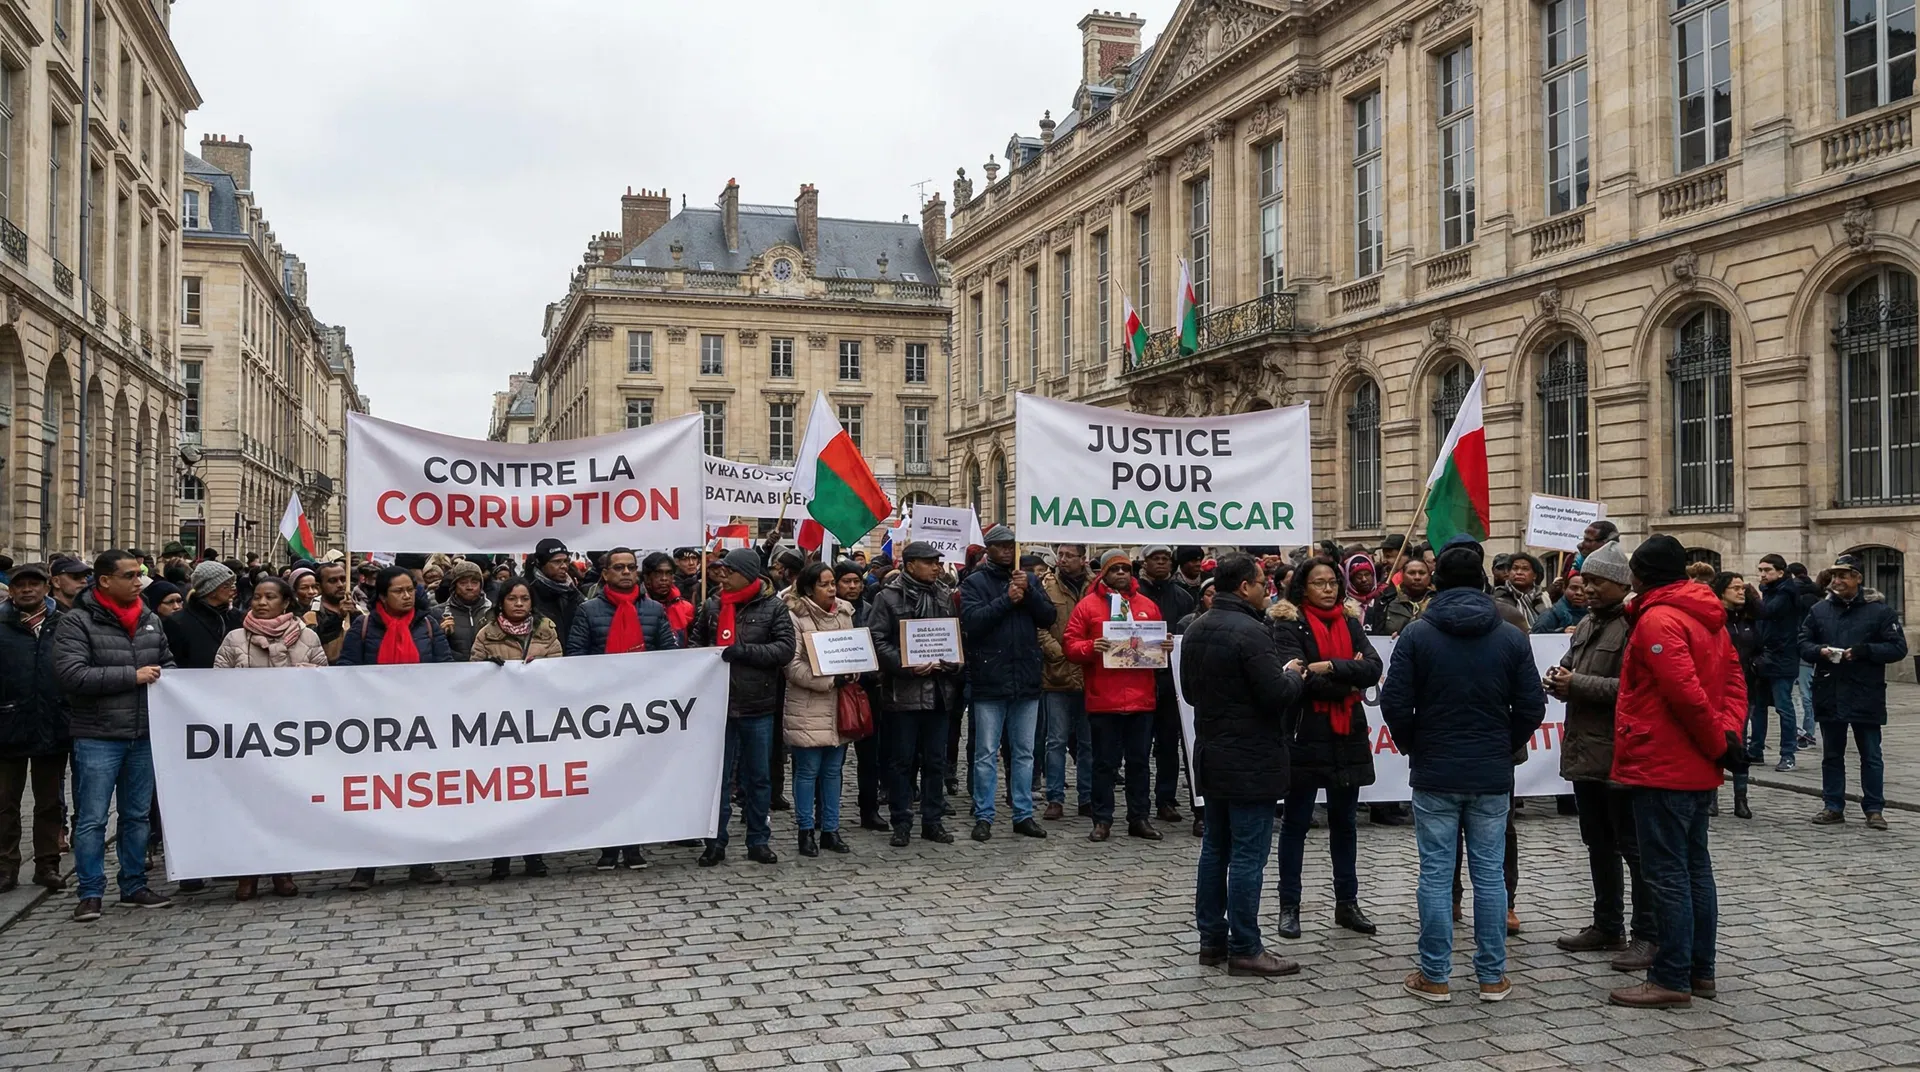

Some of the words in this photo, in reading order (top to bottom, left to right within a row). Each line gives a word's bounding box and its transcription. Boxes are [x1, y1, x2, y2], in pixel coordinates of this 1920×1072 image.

[1087, 423, 1232, 457] JUSTICE
[423, 456, 577, 488] CONTRE
[589, 455, 636, 483] LA
[1112, 461, 1212, 493] POUR
[376, 487, 680, 528] CORRUPTION
[1031, 496, 1295, 531] MADAGASCAR
[186, 715, 438, 760] DIASPORA
[451, 696, 698, 748] MALAGASY
[343, 761, 588, 811] ENSEMBLE
